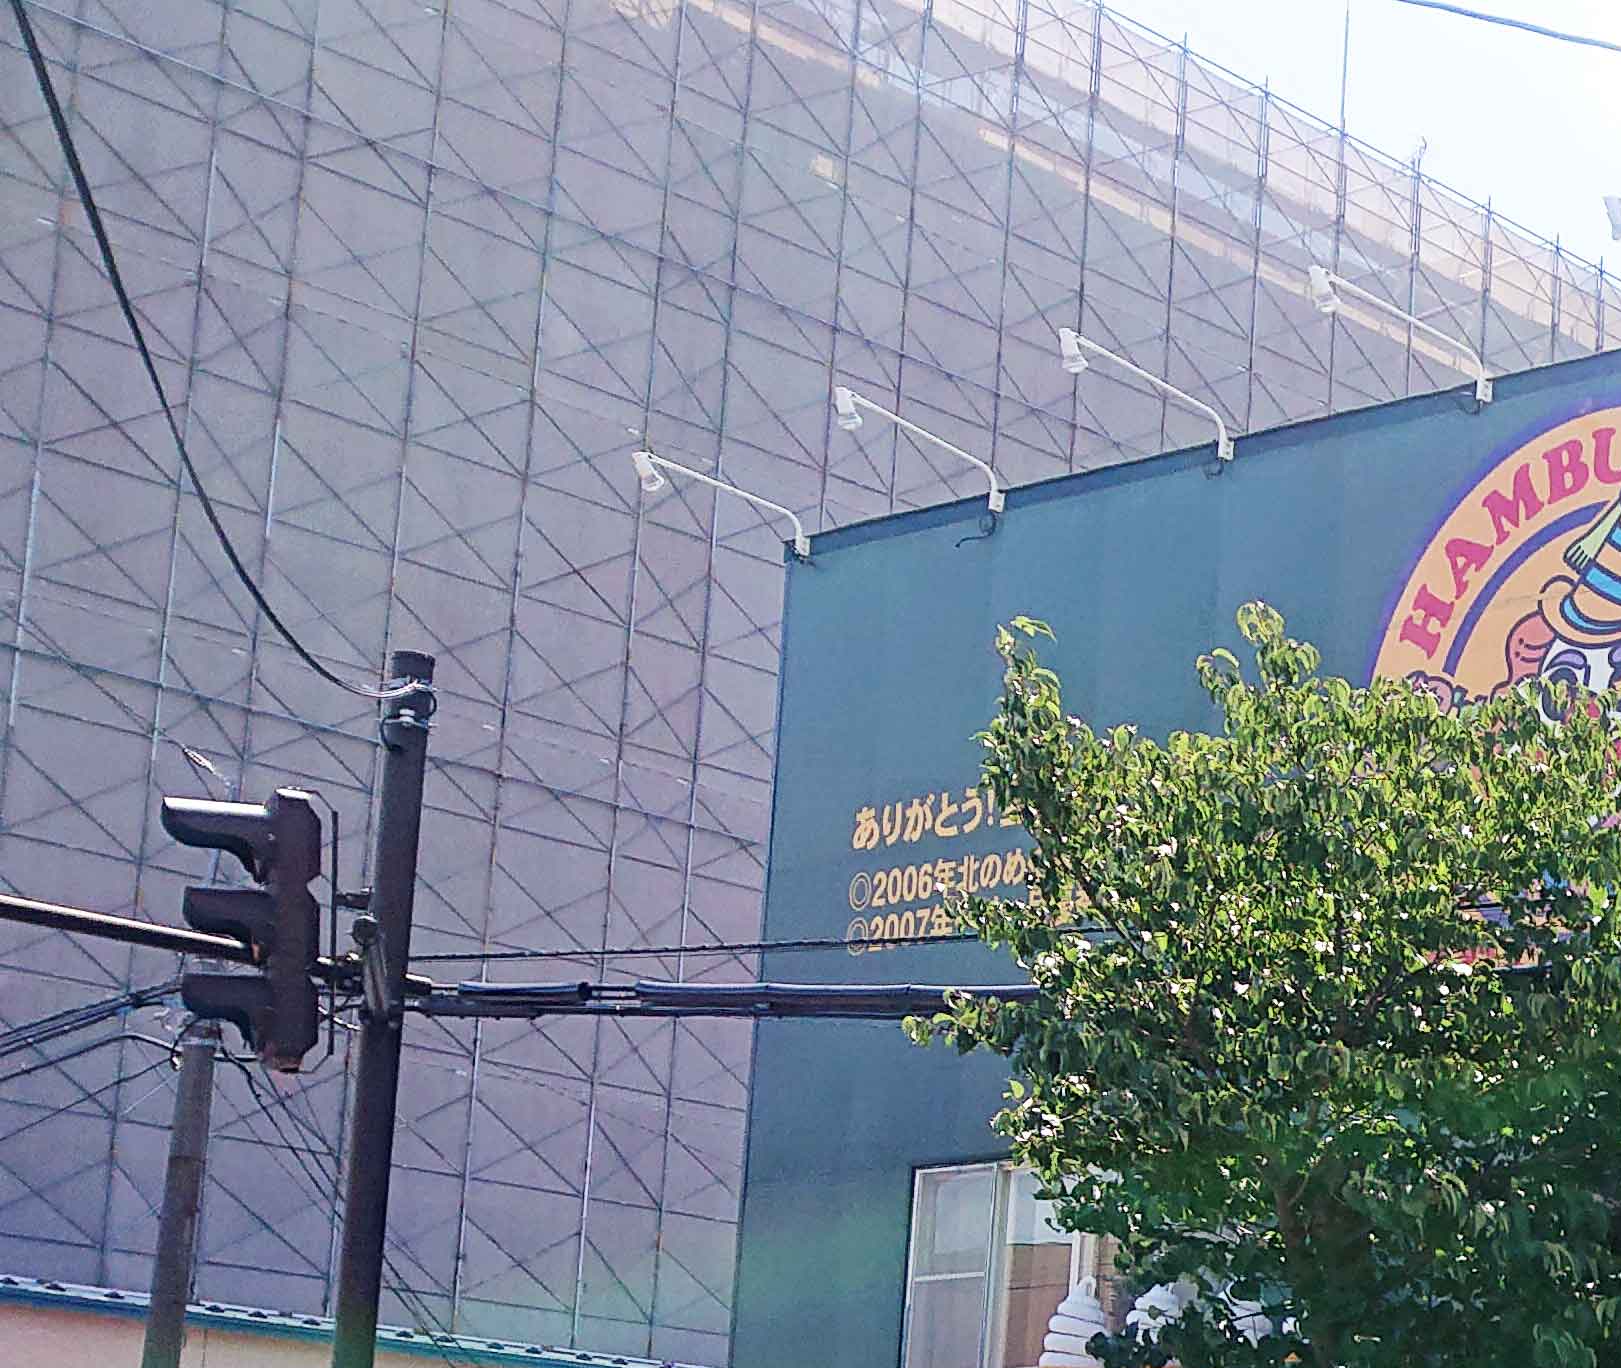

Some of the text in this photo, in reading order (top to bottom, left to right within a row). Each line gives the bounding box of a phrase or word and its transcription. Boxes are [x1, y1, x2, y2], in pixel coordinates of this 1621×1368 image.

[852, 786, 1022, 850] ありがとう!
[849, 848, 1040, 912] ◎2006年北のめ
